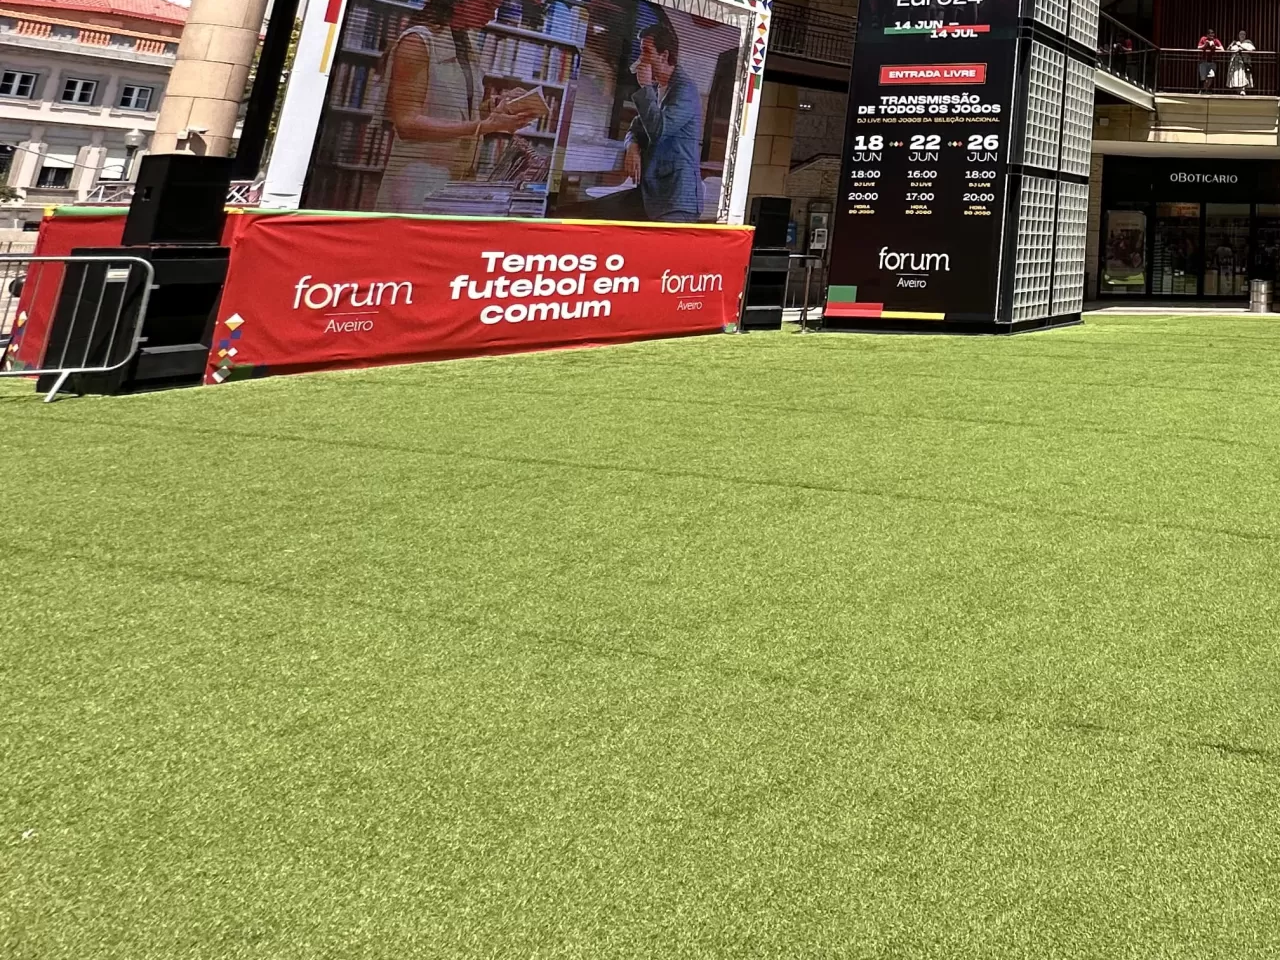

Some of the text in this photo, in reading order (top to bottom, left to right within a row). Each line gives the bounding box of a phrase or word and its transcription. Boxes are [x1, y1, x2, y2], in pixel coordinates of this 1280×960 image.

[894, 21, 911, 30] 14
[915, 20, 944, 30] JUN
[930, 29, 978, 38] 14 JUL
[888, 69, 976, 79] ENTRADA LIVRE
[880, 92, 981, 105] TRANSMISSÃO
[858, 104, 1002, 115] DE TODOS OS JOGOS
[853, 135, 884, 151] 18
[909, 134, 942, 151] 22
[967, 134, 1000, 151] 26
[852, 152, 883, 162] JUN
[907, 152, 939, 162] JUN
[966, 152, 998, 162] JUN
[851, 170, 881, 179] 18:00
[906, 170, 938, 179] 16:00
[964, 170, 997, 179] 18:00
[848, 192, 879, 201] 20:00
[905, 192, 935, 201] 17:00
[963, 193, 995, 202] 20:00
[481, 251, 625, 273] Temos o
[878, 246, 950, 272] forum
[449, 273, 640, 300] futebol em
[660, 269, 723, 294] forum
[896, 277, 927, 289] Aveiro
[292, 275, 413, 310] forum
[676, 300, 703, 312] Aveiro
[479, 299, 612, 325] comum
[323, 318, 374, 334] Aveiro
